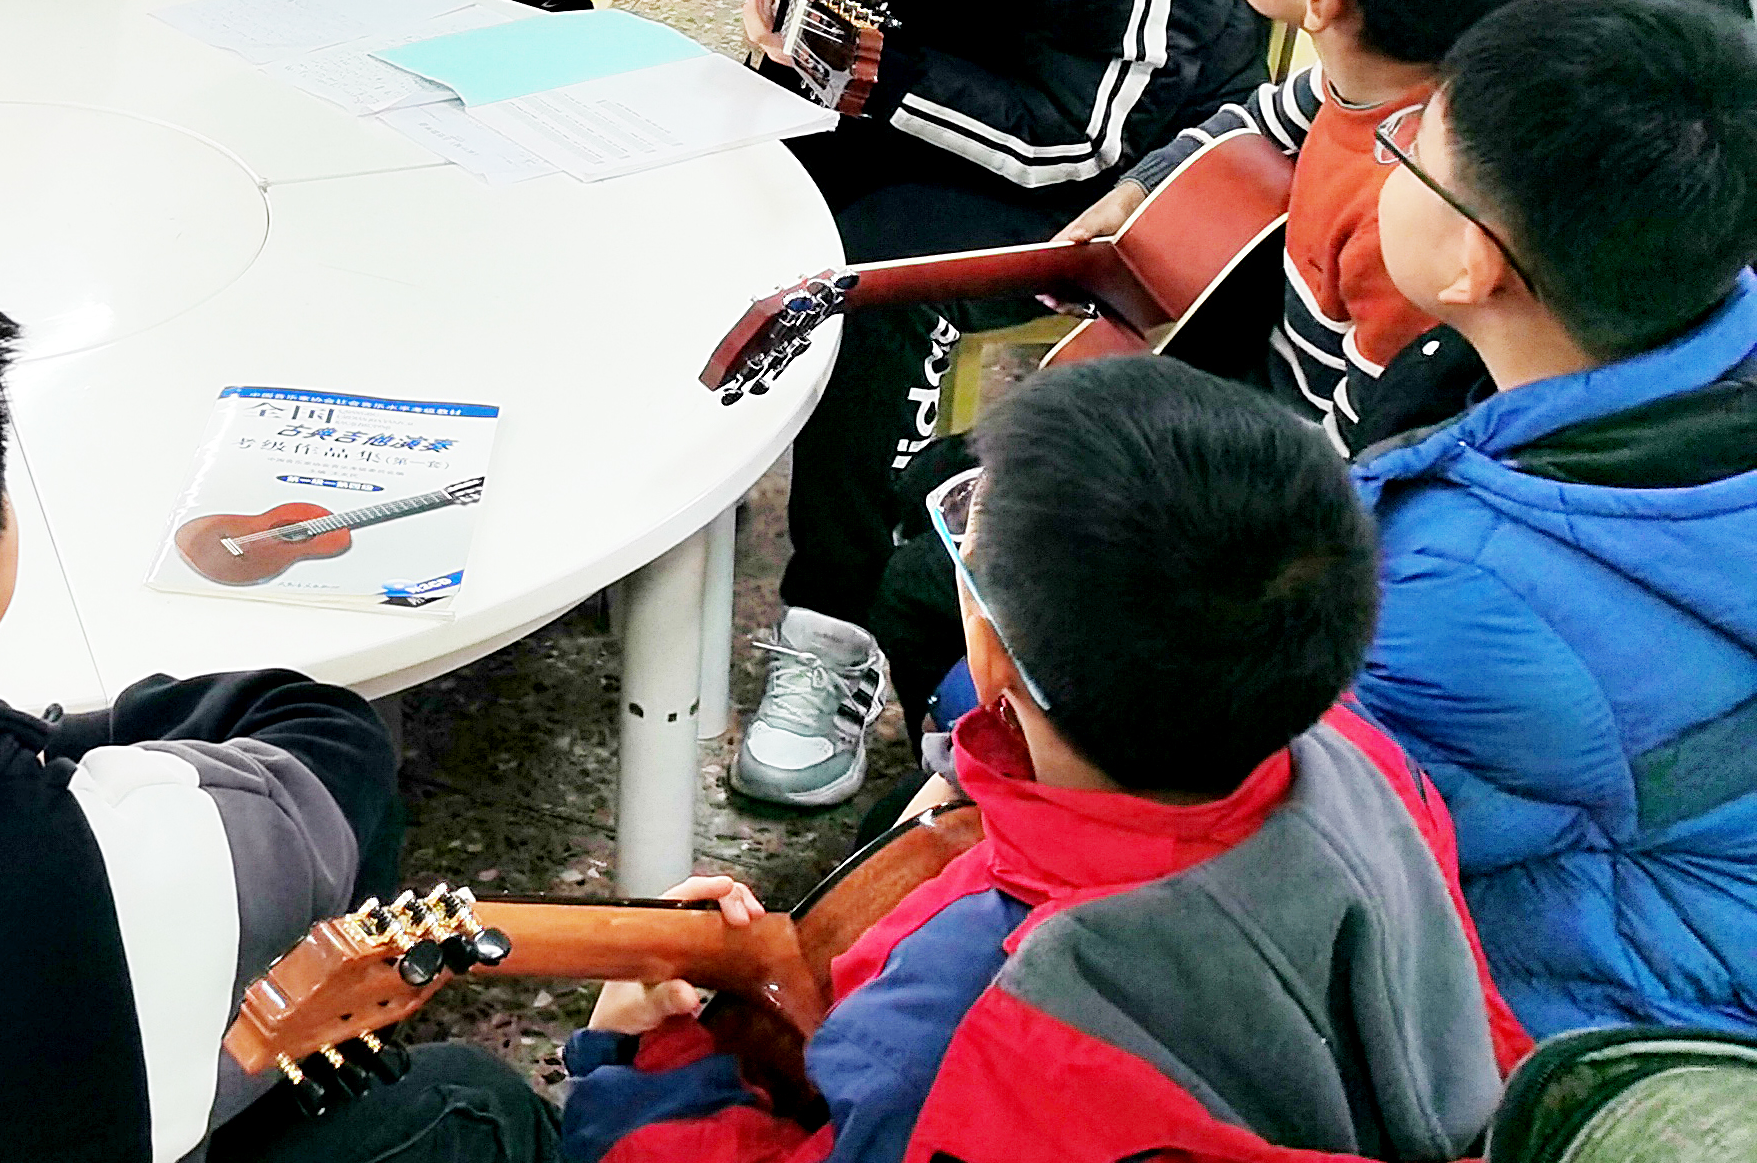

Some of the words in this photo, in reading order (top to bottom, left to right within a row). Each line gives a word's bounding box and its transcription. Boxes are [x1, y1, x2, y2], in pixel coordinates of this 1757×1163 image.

[244, 402, 335, 424] 全国
[277, 424, 460, 453] 古典吉他演奏
